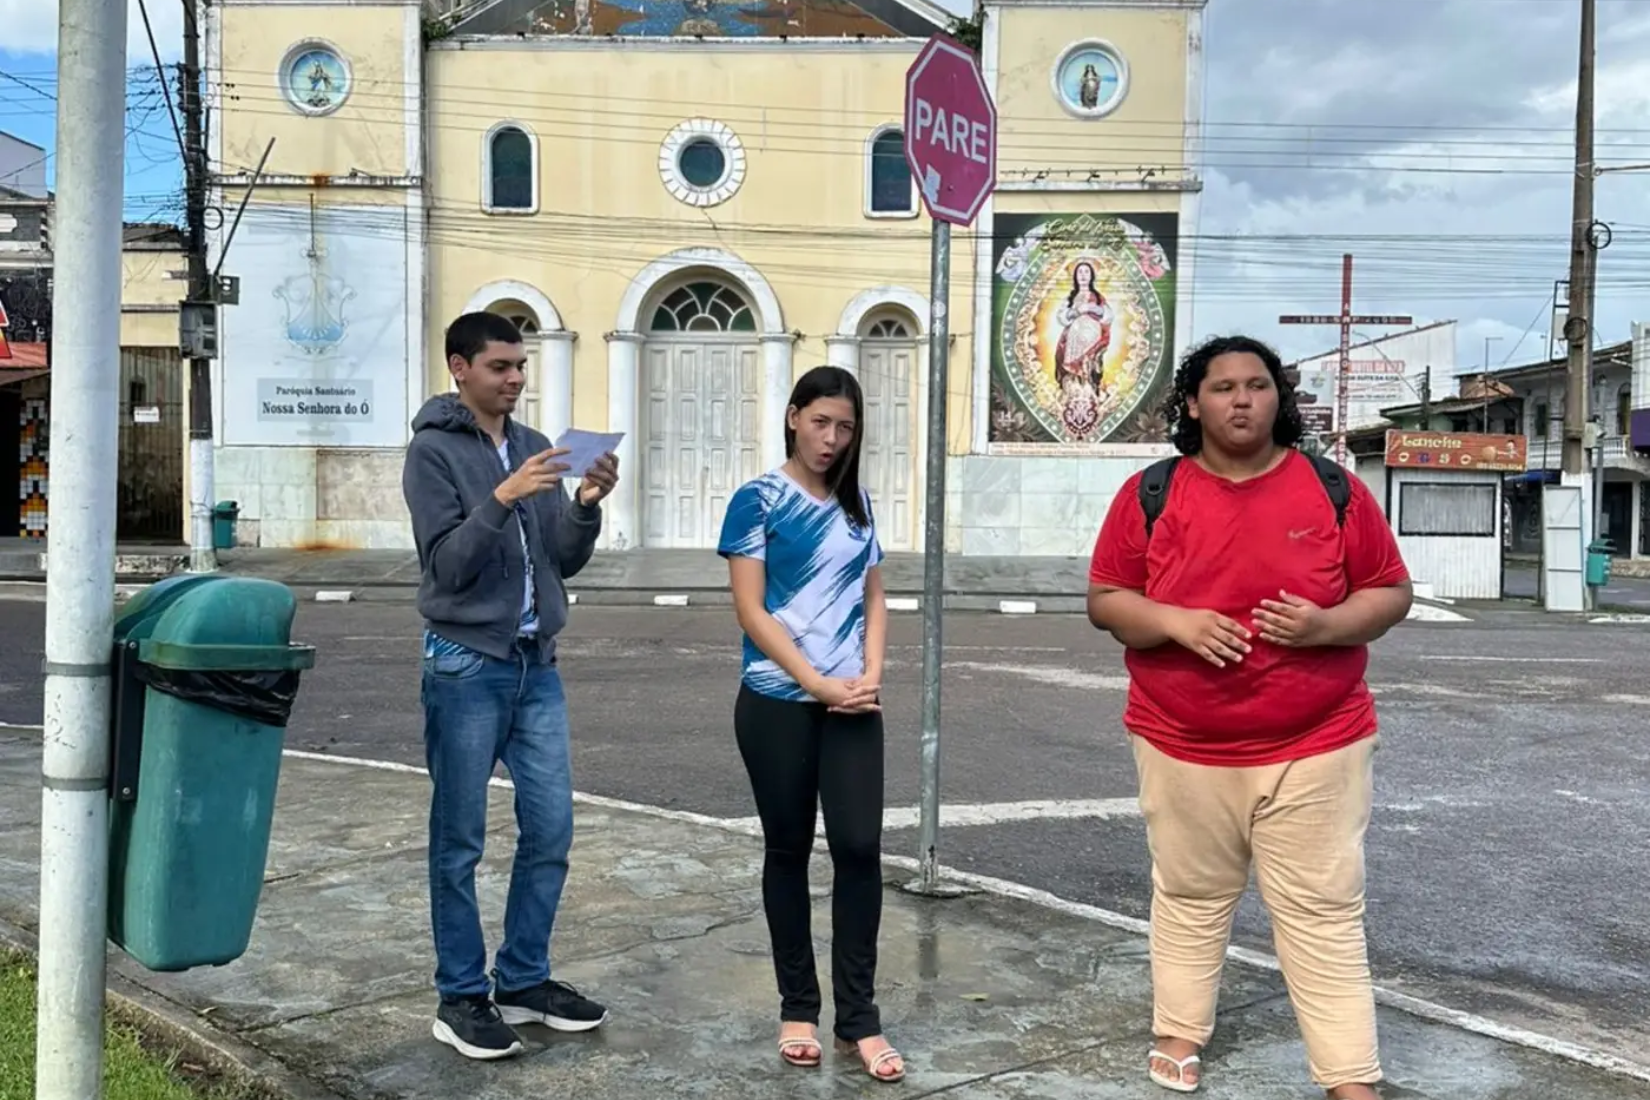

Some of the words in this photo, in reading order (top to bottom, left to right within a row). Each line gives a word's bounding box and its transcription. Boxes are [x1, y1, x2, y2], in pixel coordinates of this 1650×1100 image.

[916, 97, 988, 164] PARE
[276, 385, 313, 397] Paróquia
[315, 385, 356, 396] Santuário
[262, 401, 295, 414] Nossa
[297, 401, 342, 414] Senhora
[344, 402, 357, 414] do
[360, 399, 370, 415] Ó
